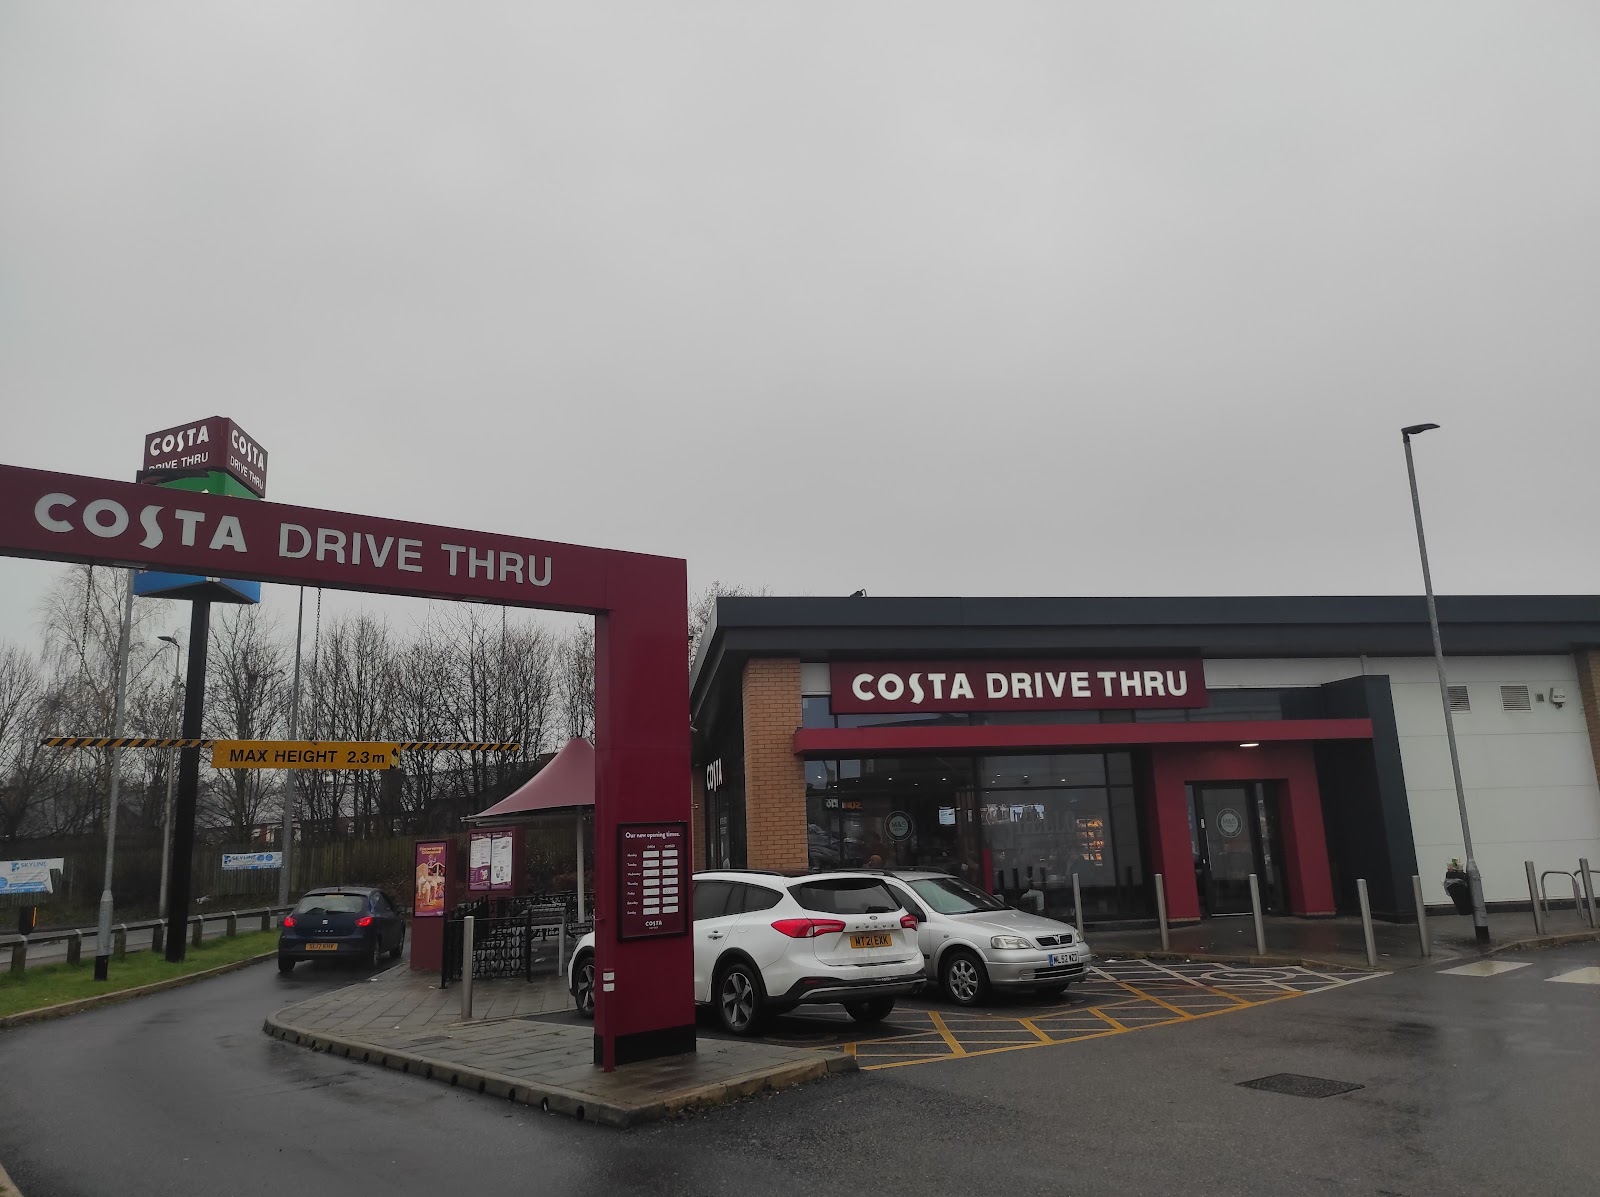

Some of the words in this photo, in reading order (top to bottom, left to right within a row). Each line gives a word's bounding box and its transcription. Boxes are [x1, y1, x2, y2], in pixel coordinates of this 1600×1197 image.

[149, 424, 209, 457] COSTA
[231, 429, 265, 471] COSTA
[180, 451, 209, 467] THRU
[229, 455, 249, 477] DRIVE
[248, 470, 264, 490] THRU
[34, 492, 248, 553] COSTA
[278, 522, 424, 574] DRIVE
[440, 542, 555, 587] THRU
[852, 672, 975, 705] COSTA
[986, 671, 1092, 699] DRIVE
[1096, 670, 1188, 698] THRU
[229, 749, 268, 763] MAX
[274, 750, 338, 763] HEIGHT
[706, 757, 723, 792] COSTA
[625, 831, 636, 839] Our
[647, 831, 666, 840] opening
